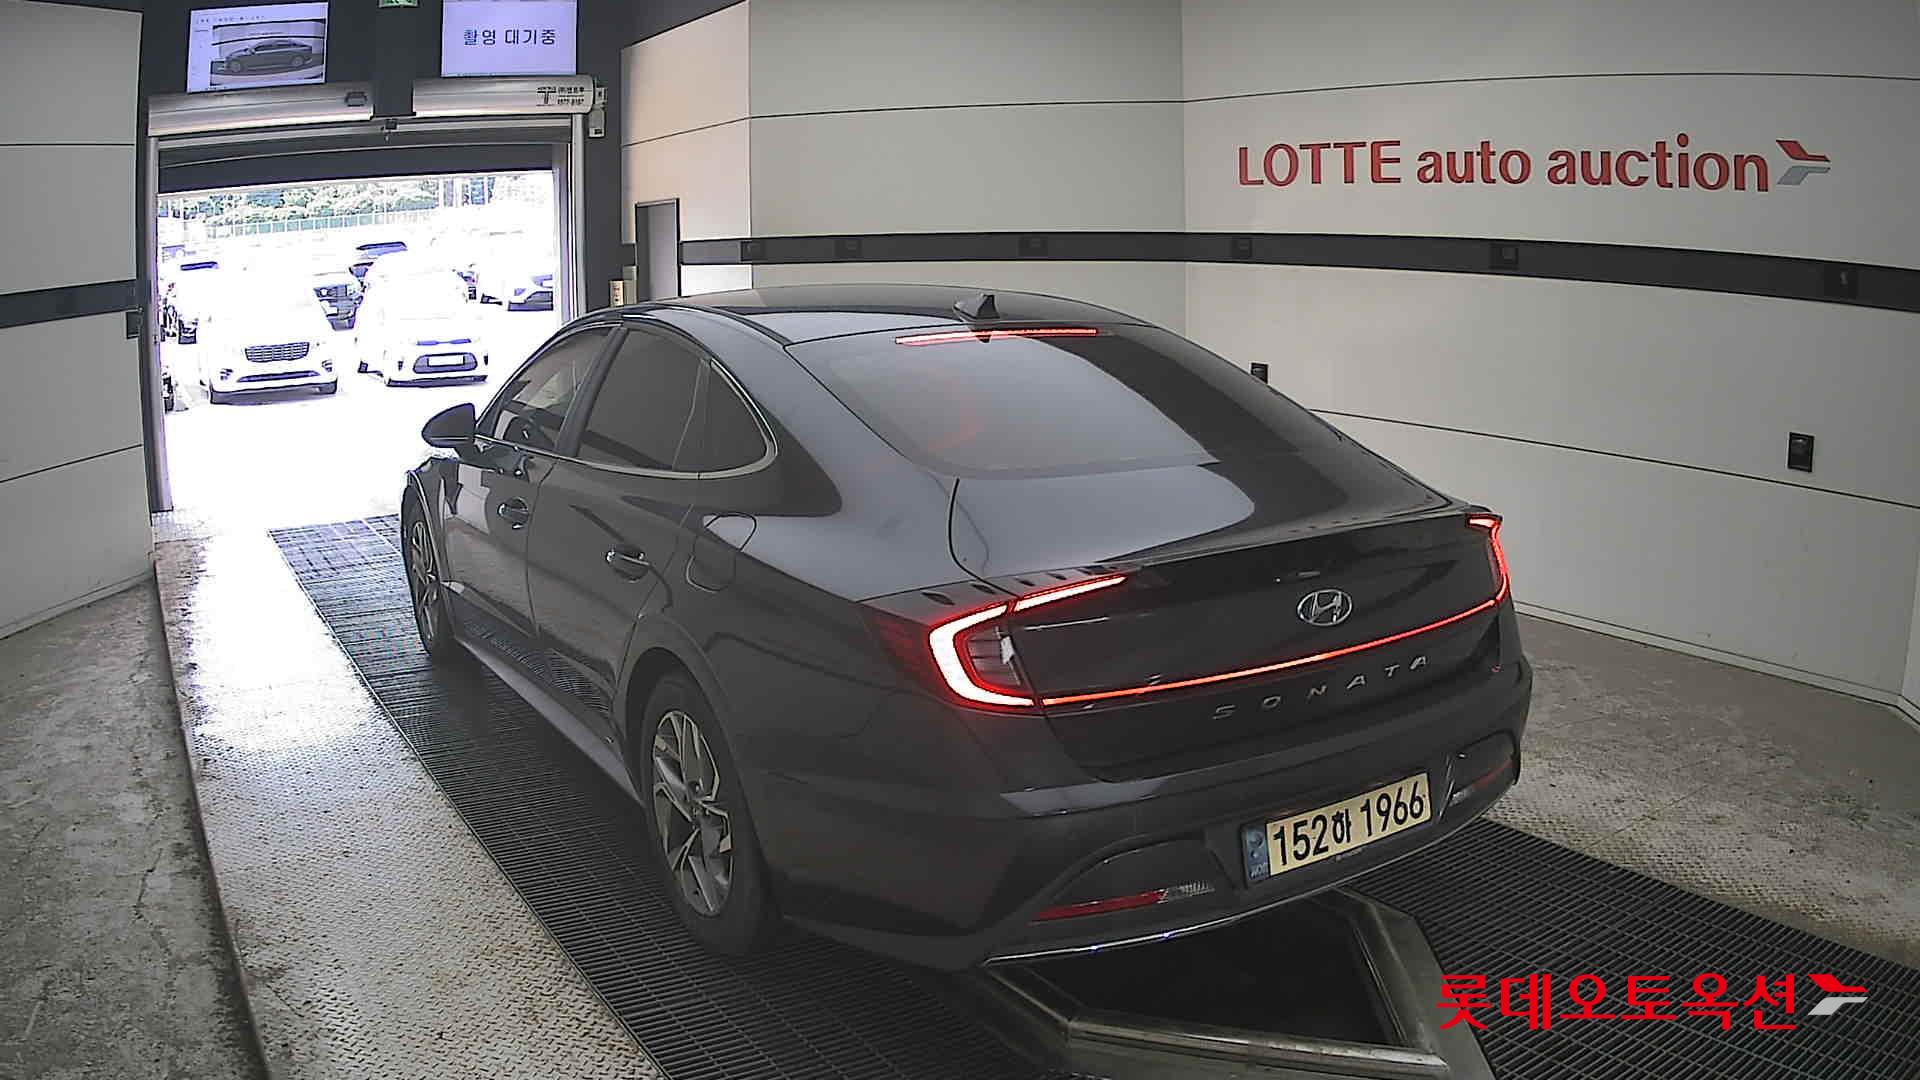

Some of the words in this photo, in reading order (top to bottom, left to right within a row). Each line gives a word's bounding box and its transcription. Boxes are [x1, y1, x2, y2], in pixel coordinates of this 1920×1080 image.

[464, 29, 496, 46] 촬영
[504, 28, 556, 46] 대기중
[1238, 140, 1400, 188] LOTTE
[1417, 140, 1532, 186] auto
[1547, 134, 1769, 190] auction
[1212, 655, 1428, 720] SONATA
[1273, 809, 1352, 867] 152하
[1359, 781, 1424, 837] 1966
